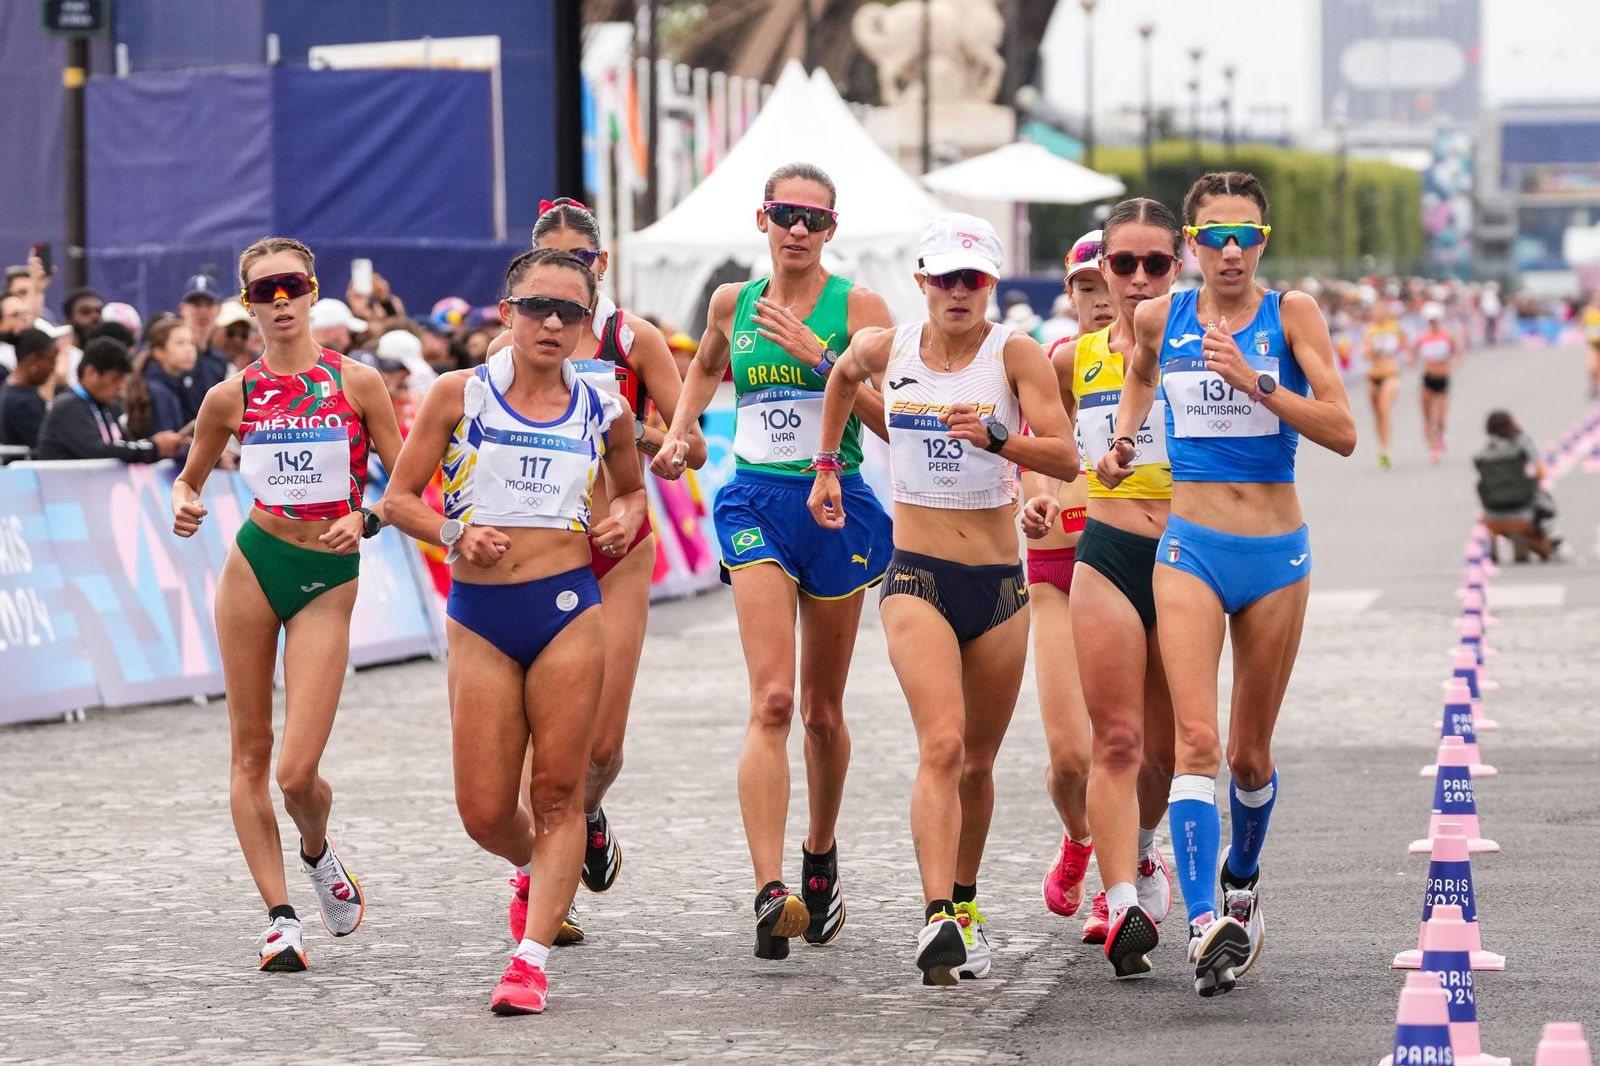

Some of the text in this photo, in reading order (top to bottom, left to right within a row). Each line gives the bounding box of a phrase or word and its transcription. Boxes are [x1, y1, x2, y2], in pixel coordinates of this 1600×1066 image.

[748, 364, 807, 386] BRASIL
[779, 390, 802, 398] 2024
[1186, 404, 1252, 415] PALMISANO
[255, 412, 342, 432] MÉXICO
[760, 408, 802, 431] 106
[295, 431, 321, 439] 2024
[541, 437, 567, 447] 2024
[771, 432, 796, 443] LYRA
[923, 438, 964, 460] 123
[274, 450, 314, 472] 142
[519, 455, 553, 479] 117
[928, 461, 961, 472] PEREZ
[267, 473, 323, 485] GONZALEZ
[505, 479, 561, 495] MOREJON
[1066, 510, 1088, 520] CHIN
[1427, 893, 1469, 907] 2024
[1427, 970, 1473, 987] ARIS
